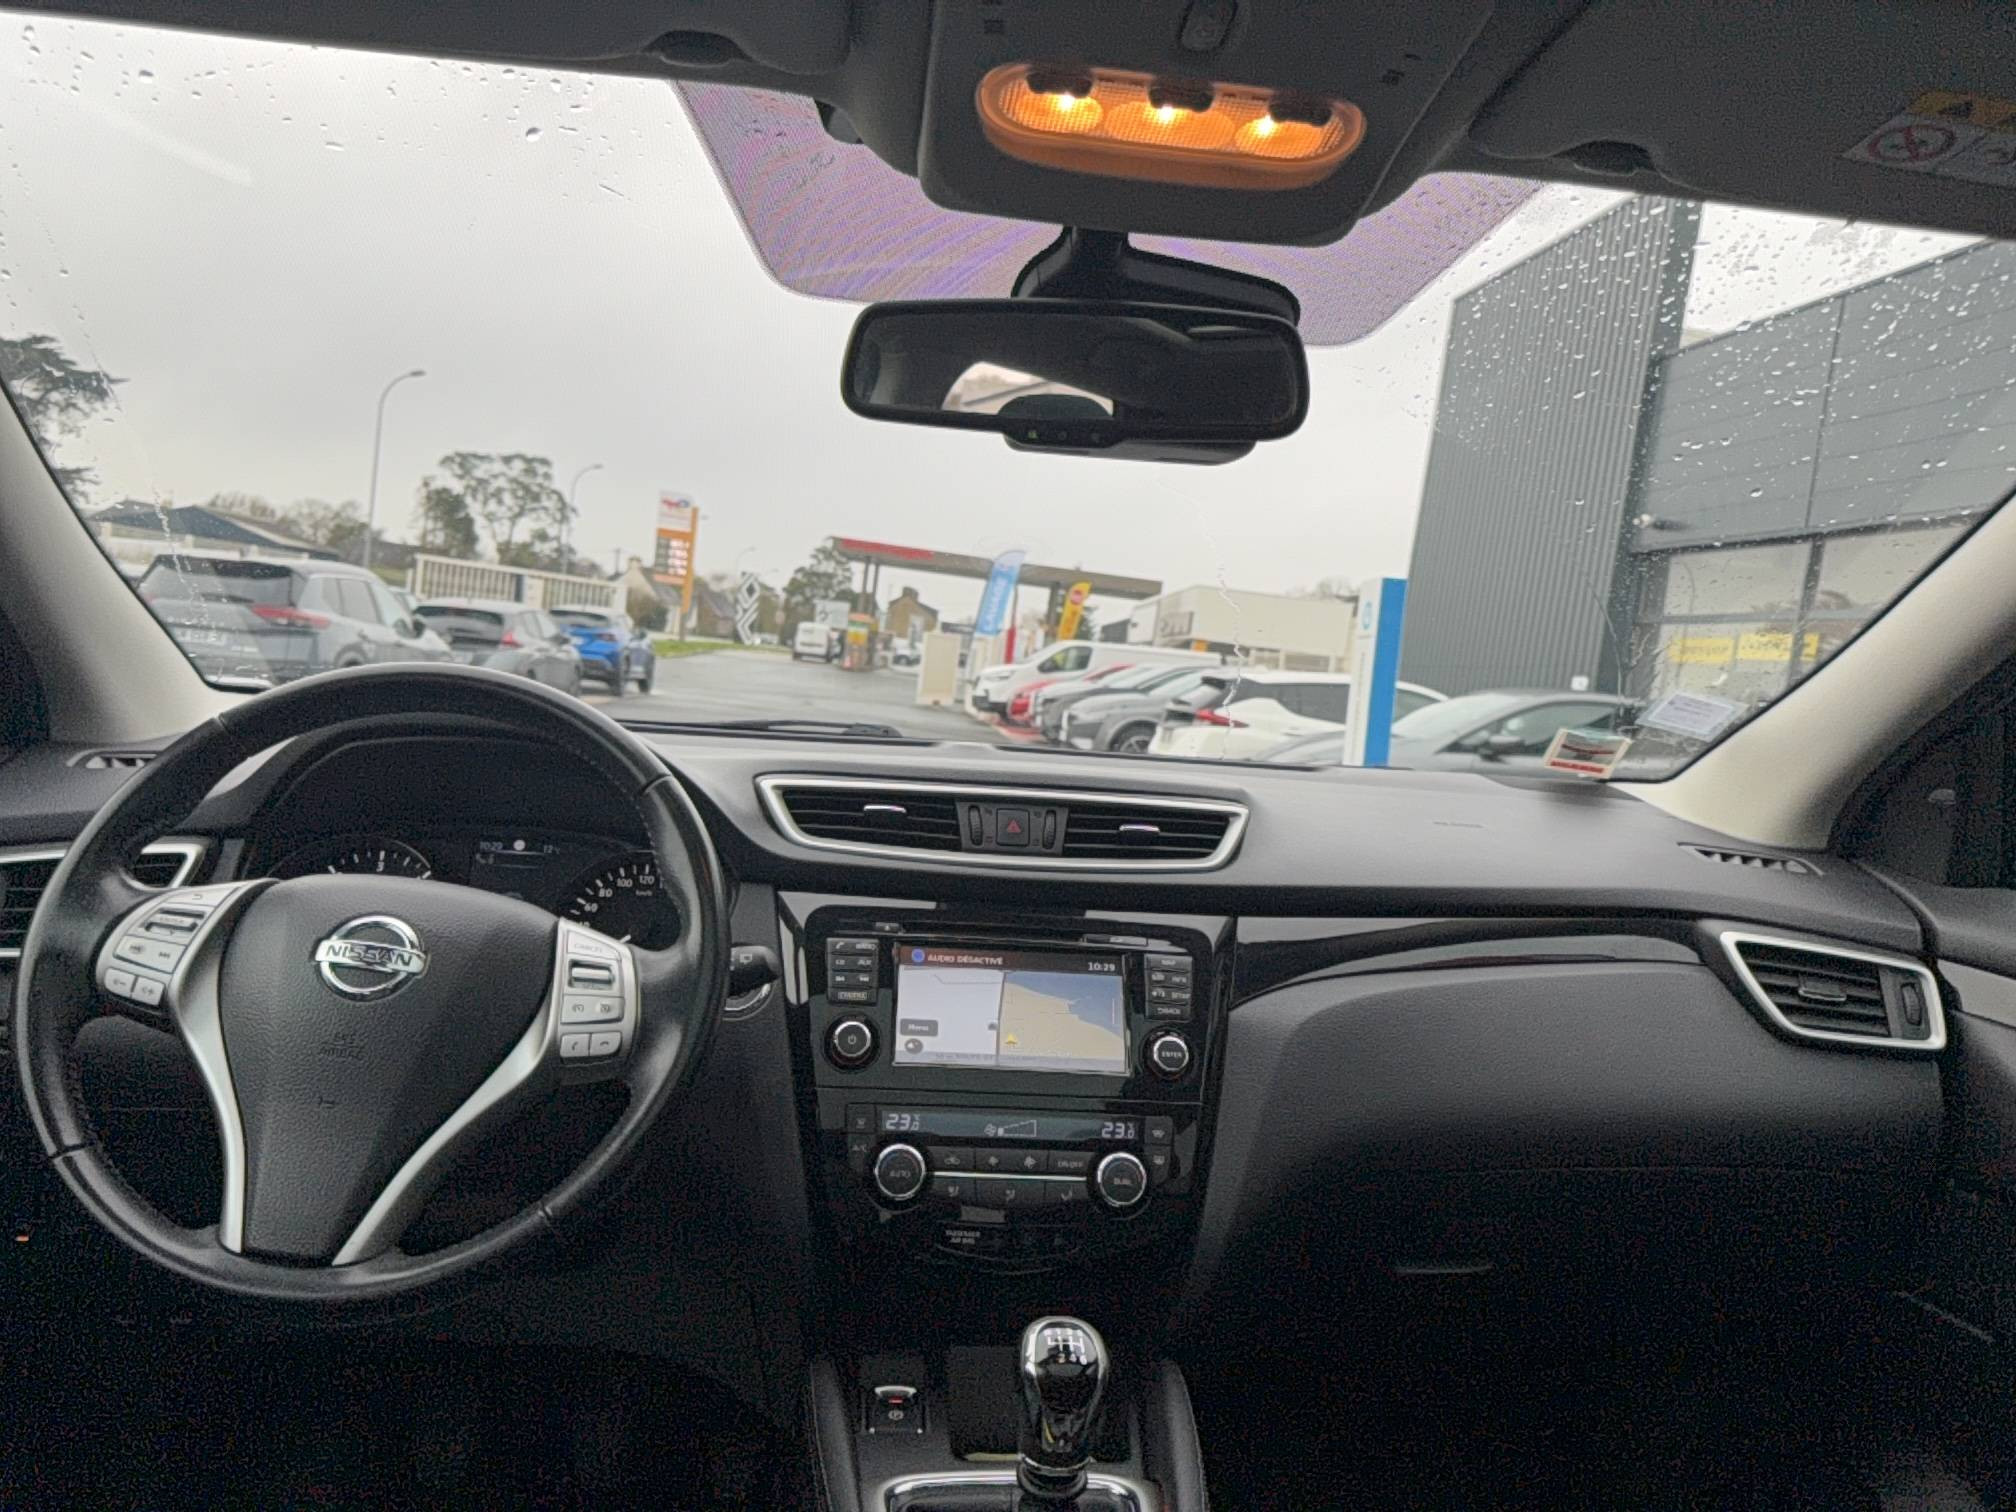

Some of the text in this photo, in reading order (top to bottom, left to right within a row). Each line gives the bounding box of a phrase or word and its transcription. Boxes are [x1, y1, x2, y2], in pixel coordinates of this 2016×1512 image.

[617, 878, 633, 888] 100
[639, 875, 655, 885] 120
[599, 888, 613, 898] 80
[584, 902, 598, 913] 60
[325, 943, 413, 968] NISSAN
[927, 954, 955, 963] AUDIO
[1087, 961, 1116, 972] 10:29
